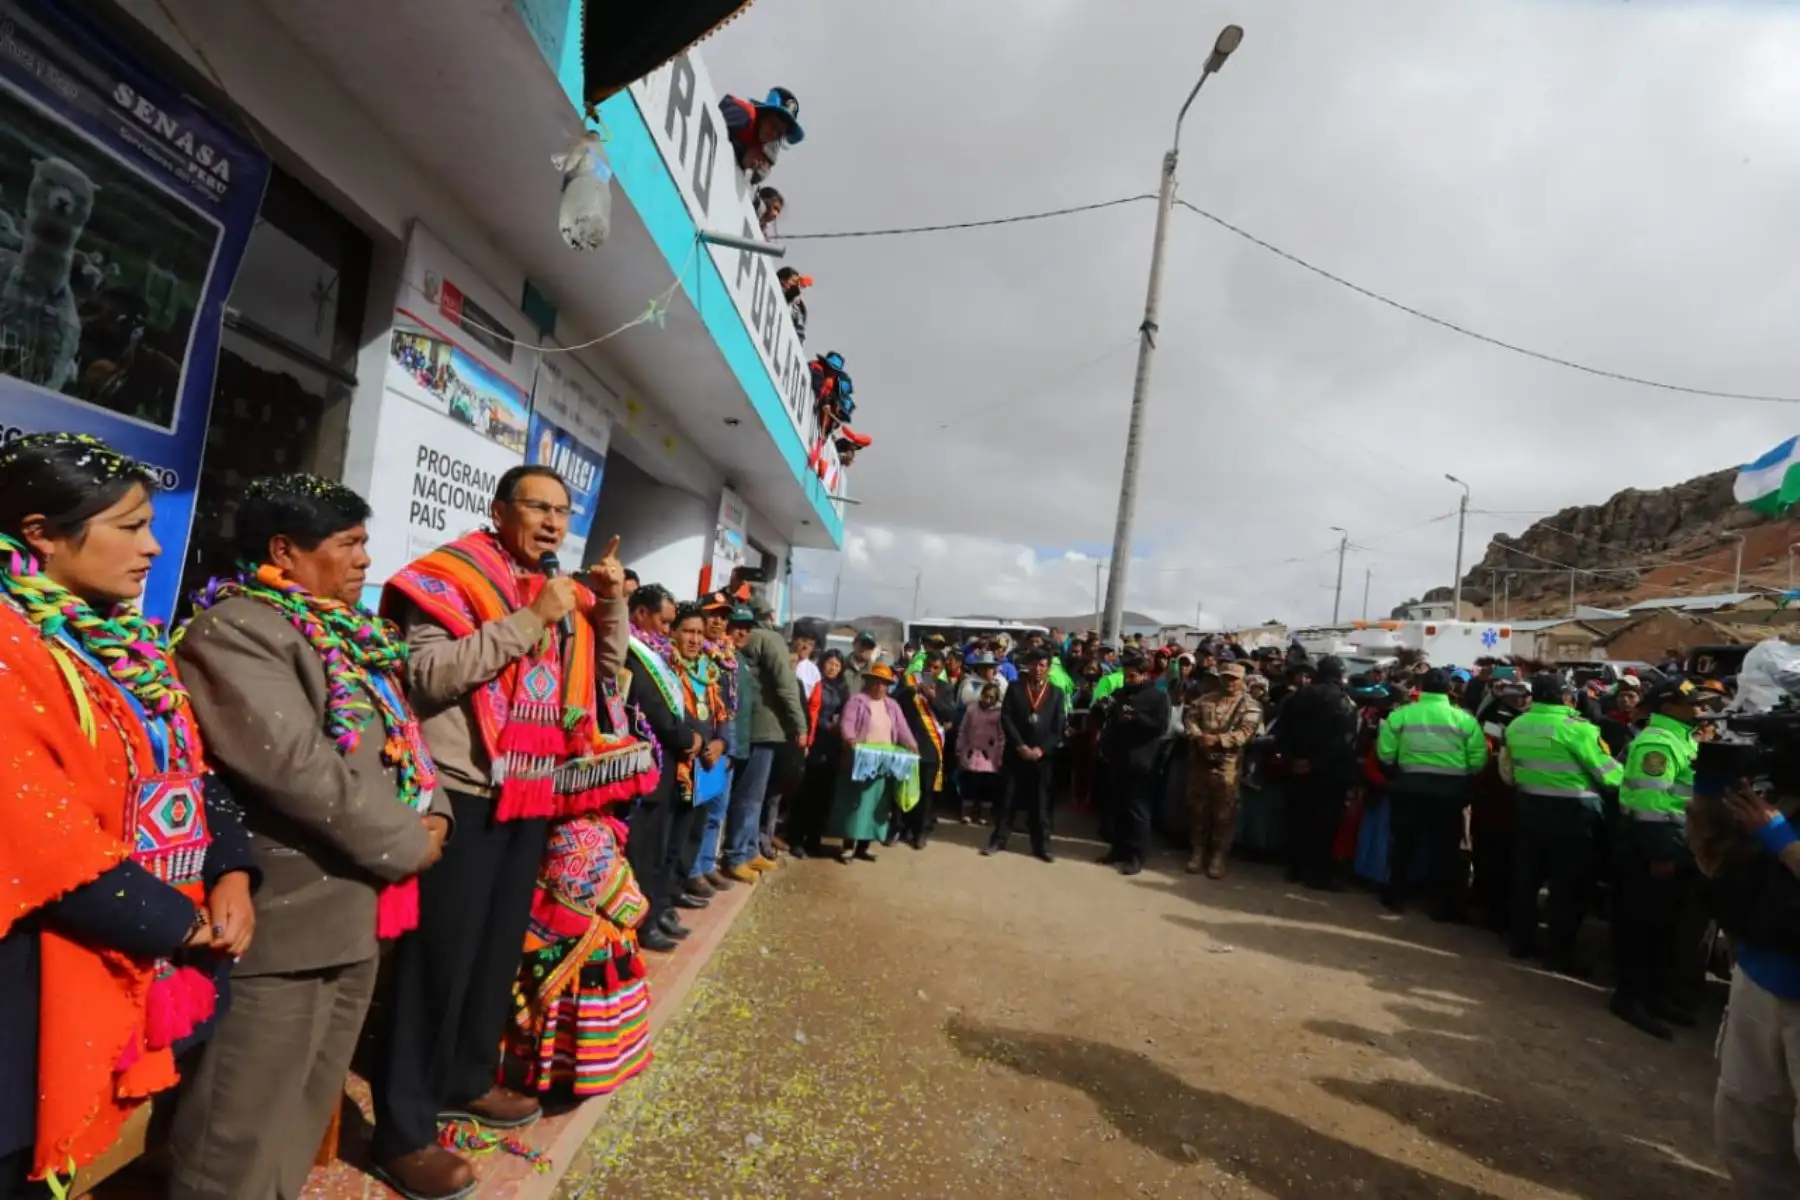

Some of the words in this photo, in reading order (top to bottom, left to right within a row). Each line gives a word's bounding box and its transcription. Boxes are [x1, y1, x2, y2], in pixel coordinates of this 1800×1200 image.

[112, 81, 230, 183] SENASA
[643, 53, 718, 218] RO
[416, 444, 497, 495] PROGRAM
[409, 500, 446, 531] PAIS
[412, 472, 493, 519] NACIONAL
